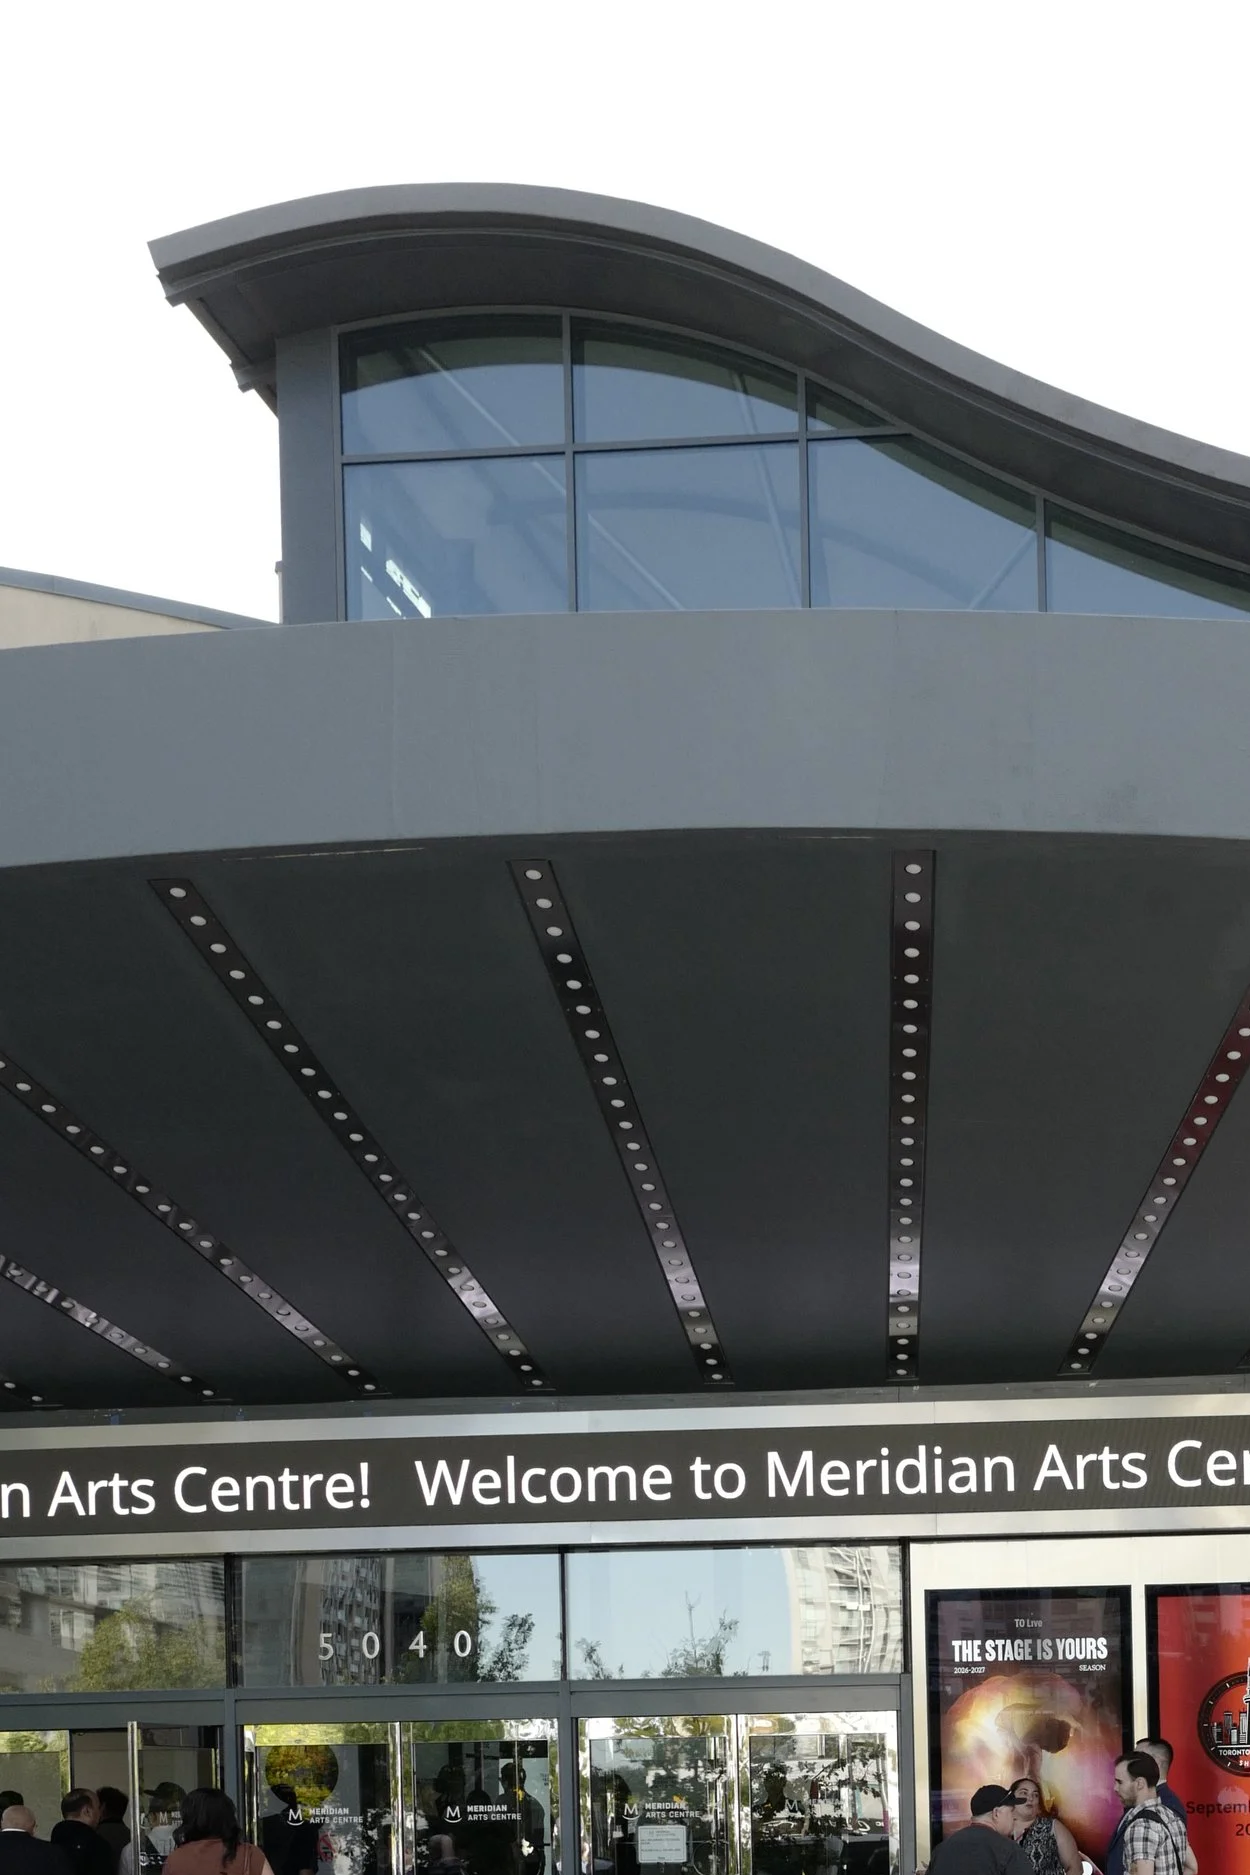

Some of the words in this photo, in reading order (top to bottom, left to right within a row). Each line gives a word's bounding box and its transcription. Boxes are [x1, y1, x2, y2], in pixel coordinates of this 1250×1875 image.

[47, 1470, 156, 1517] Arts
[174, 1461, 370, 1514] Centre!
[414, 1455, 673, 1506] Welcome
[689, 1456, 746, 1500] to
[767, 1444, 1015, 1498] Meridian
[1032, 1439, 1148, 1491] Arts
[1014, 1618, 1025, 1628] TO
[318, 1630, 472, 1661] 5040
[951, 1639, 982, 1662] THE
[985, 1639, 1033, 1661] STAGE
[1037, 1638, 1053, 1660] IS
[1055, 1637, 1108, 1660] YOURS
[953, 1666, 986, 1674] 2026-2027
[645, 1802, 686, 1810] MERIDIAN
[309, 1807, 349, 1815] MERIDIAN
[669, 1810, 700, 1818] CENTRE
[333, 1816, 363, 1824] CENTRE
[491, 1813, 522, 1821] CENTRE
